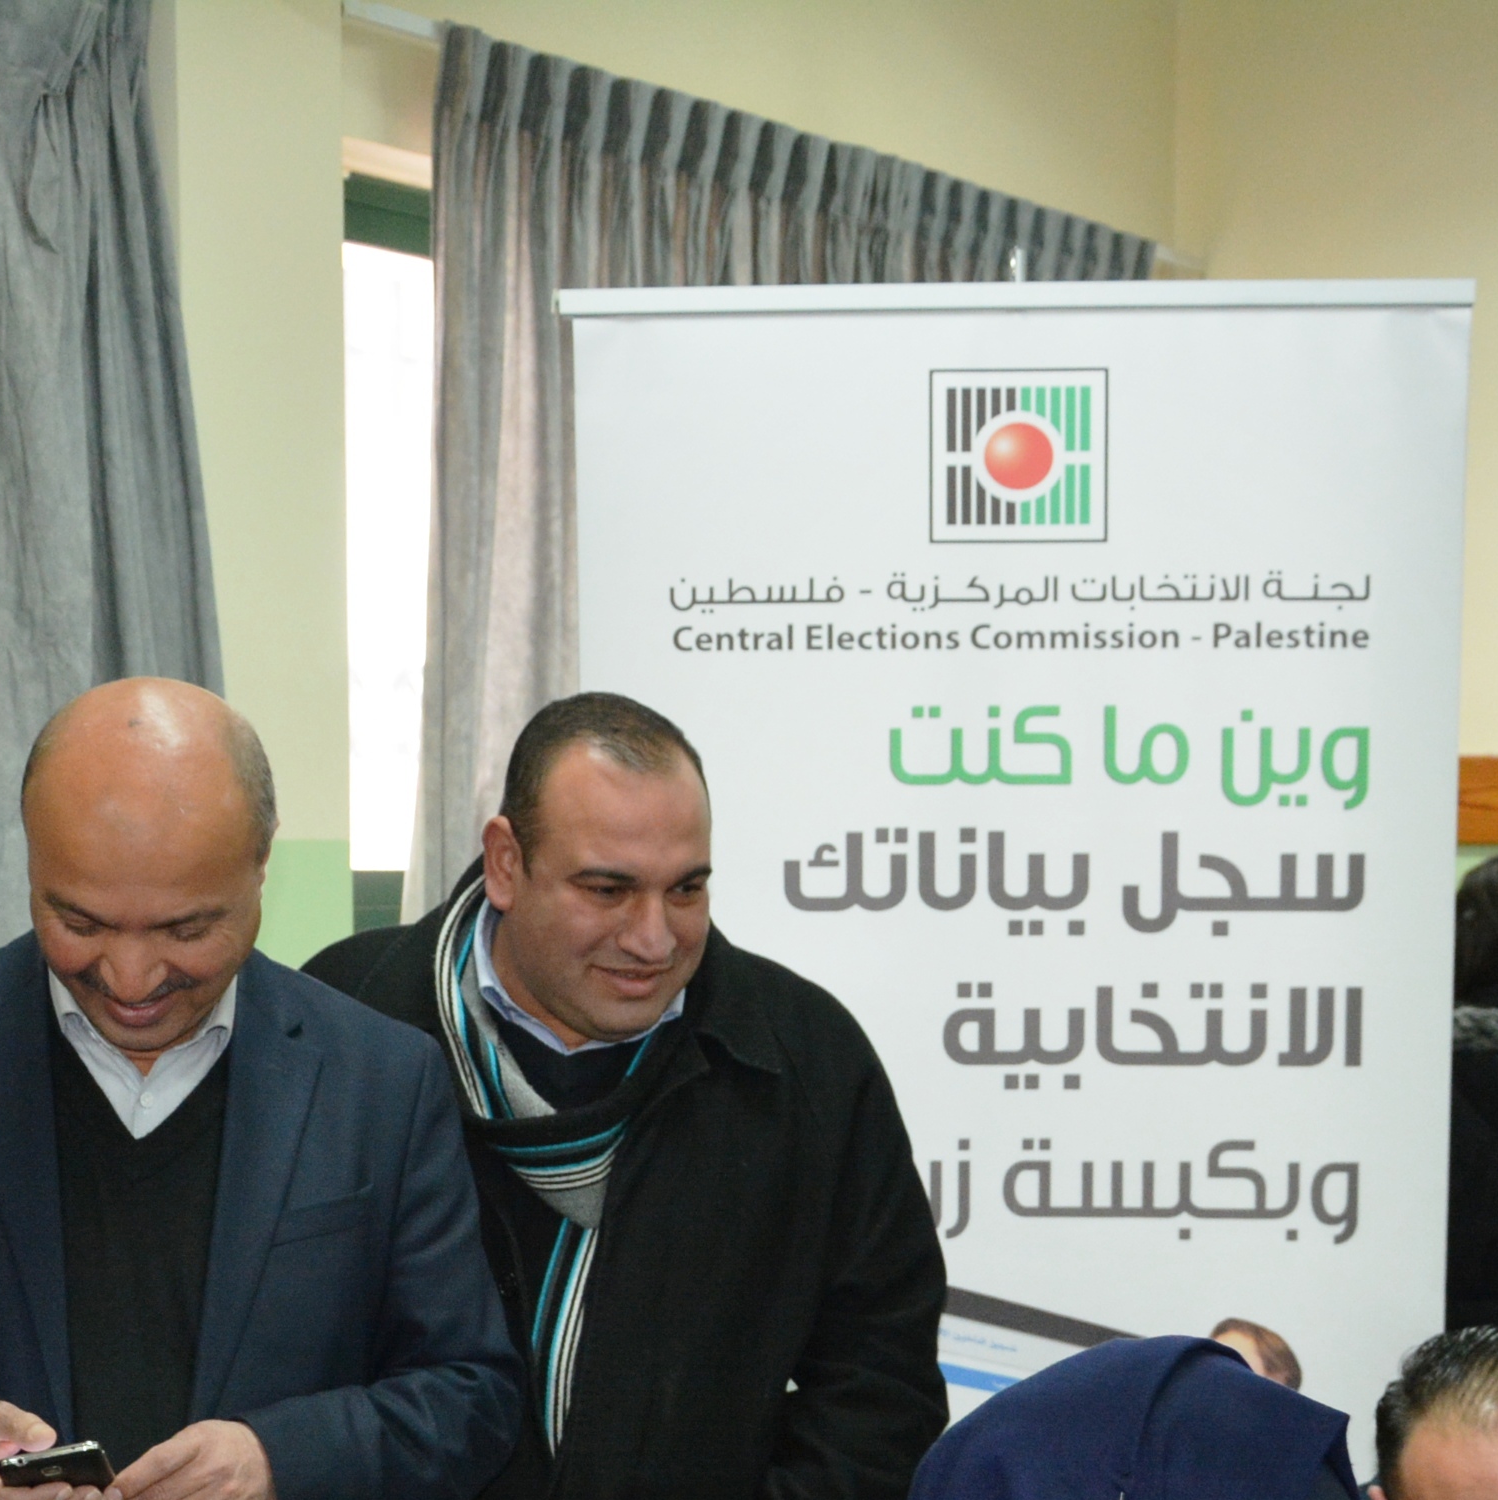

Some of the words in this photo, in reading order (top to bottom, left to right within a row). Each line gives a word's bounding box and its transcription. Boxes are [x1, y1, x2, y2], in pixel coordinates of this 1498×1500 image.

[668, 576, 846, 614] فلسطين
[886, 572, 1058, 613] المركزية
[1071, 574, 1250, 611] الانتخابات
[1262, 570, 1371, 611] لجنة
[672, 623, 794, 653] Central
[806, 622, 960, 652] Elections
[970, 622, 1180, 651] Commission
[1213, 620, 1371, 650] Palestine
[888, 704, 1073, 788] كنت
[1102, 704, 1191, 787] ما
[1220, 708, 1371, 811] وين
[783, 827, 1091, 937] بياناتك
[1122, 830, 1366, 937] سجل
[942, 982, 1364, 1091] الانتخابية
[1002, 1138, 1361, 1245] وبكبسة
